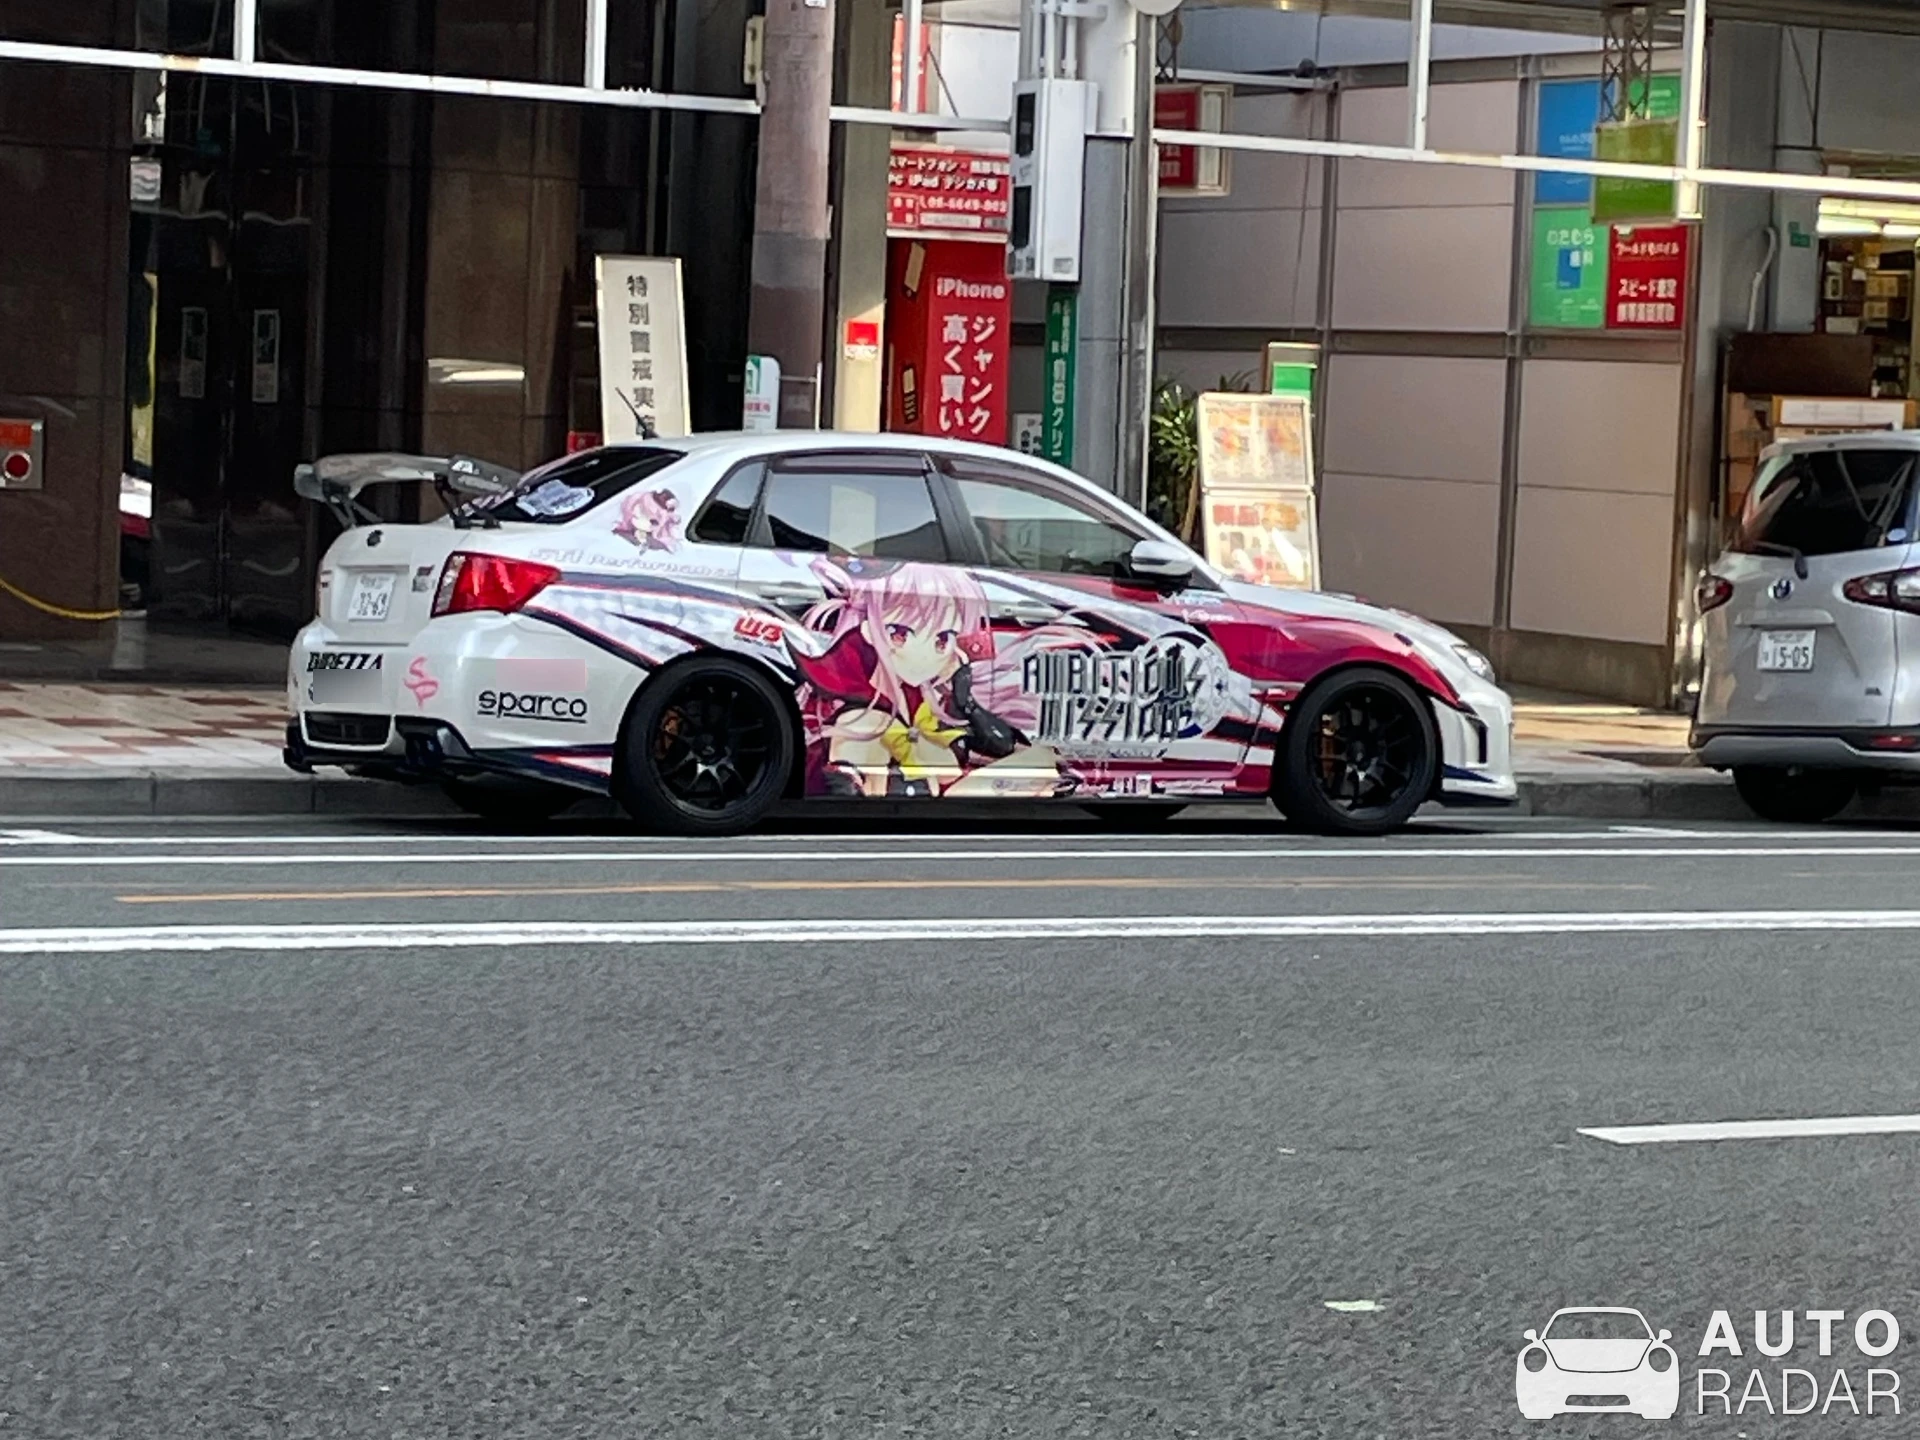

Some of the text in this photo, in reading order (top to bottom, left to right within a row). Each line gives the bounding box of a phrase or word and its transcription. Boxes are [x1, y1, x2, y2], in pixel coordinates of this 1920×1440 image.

[936, 277, 1006, 300] iPhone
[968, 315, 996, 434] ジャンク
[478, 690, 588, 719] sparco
